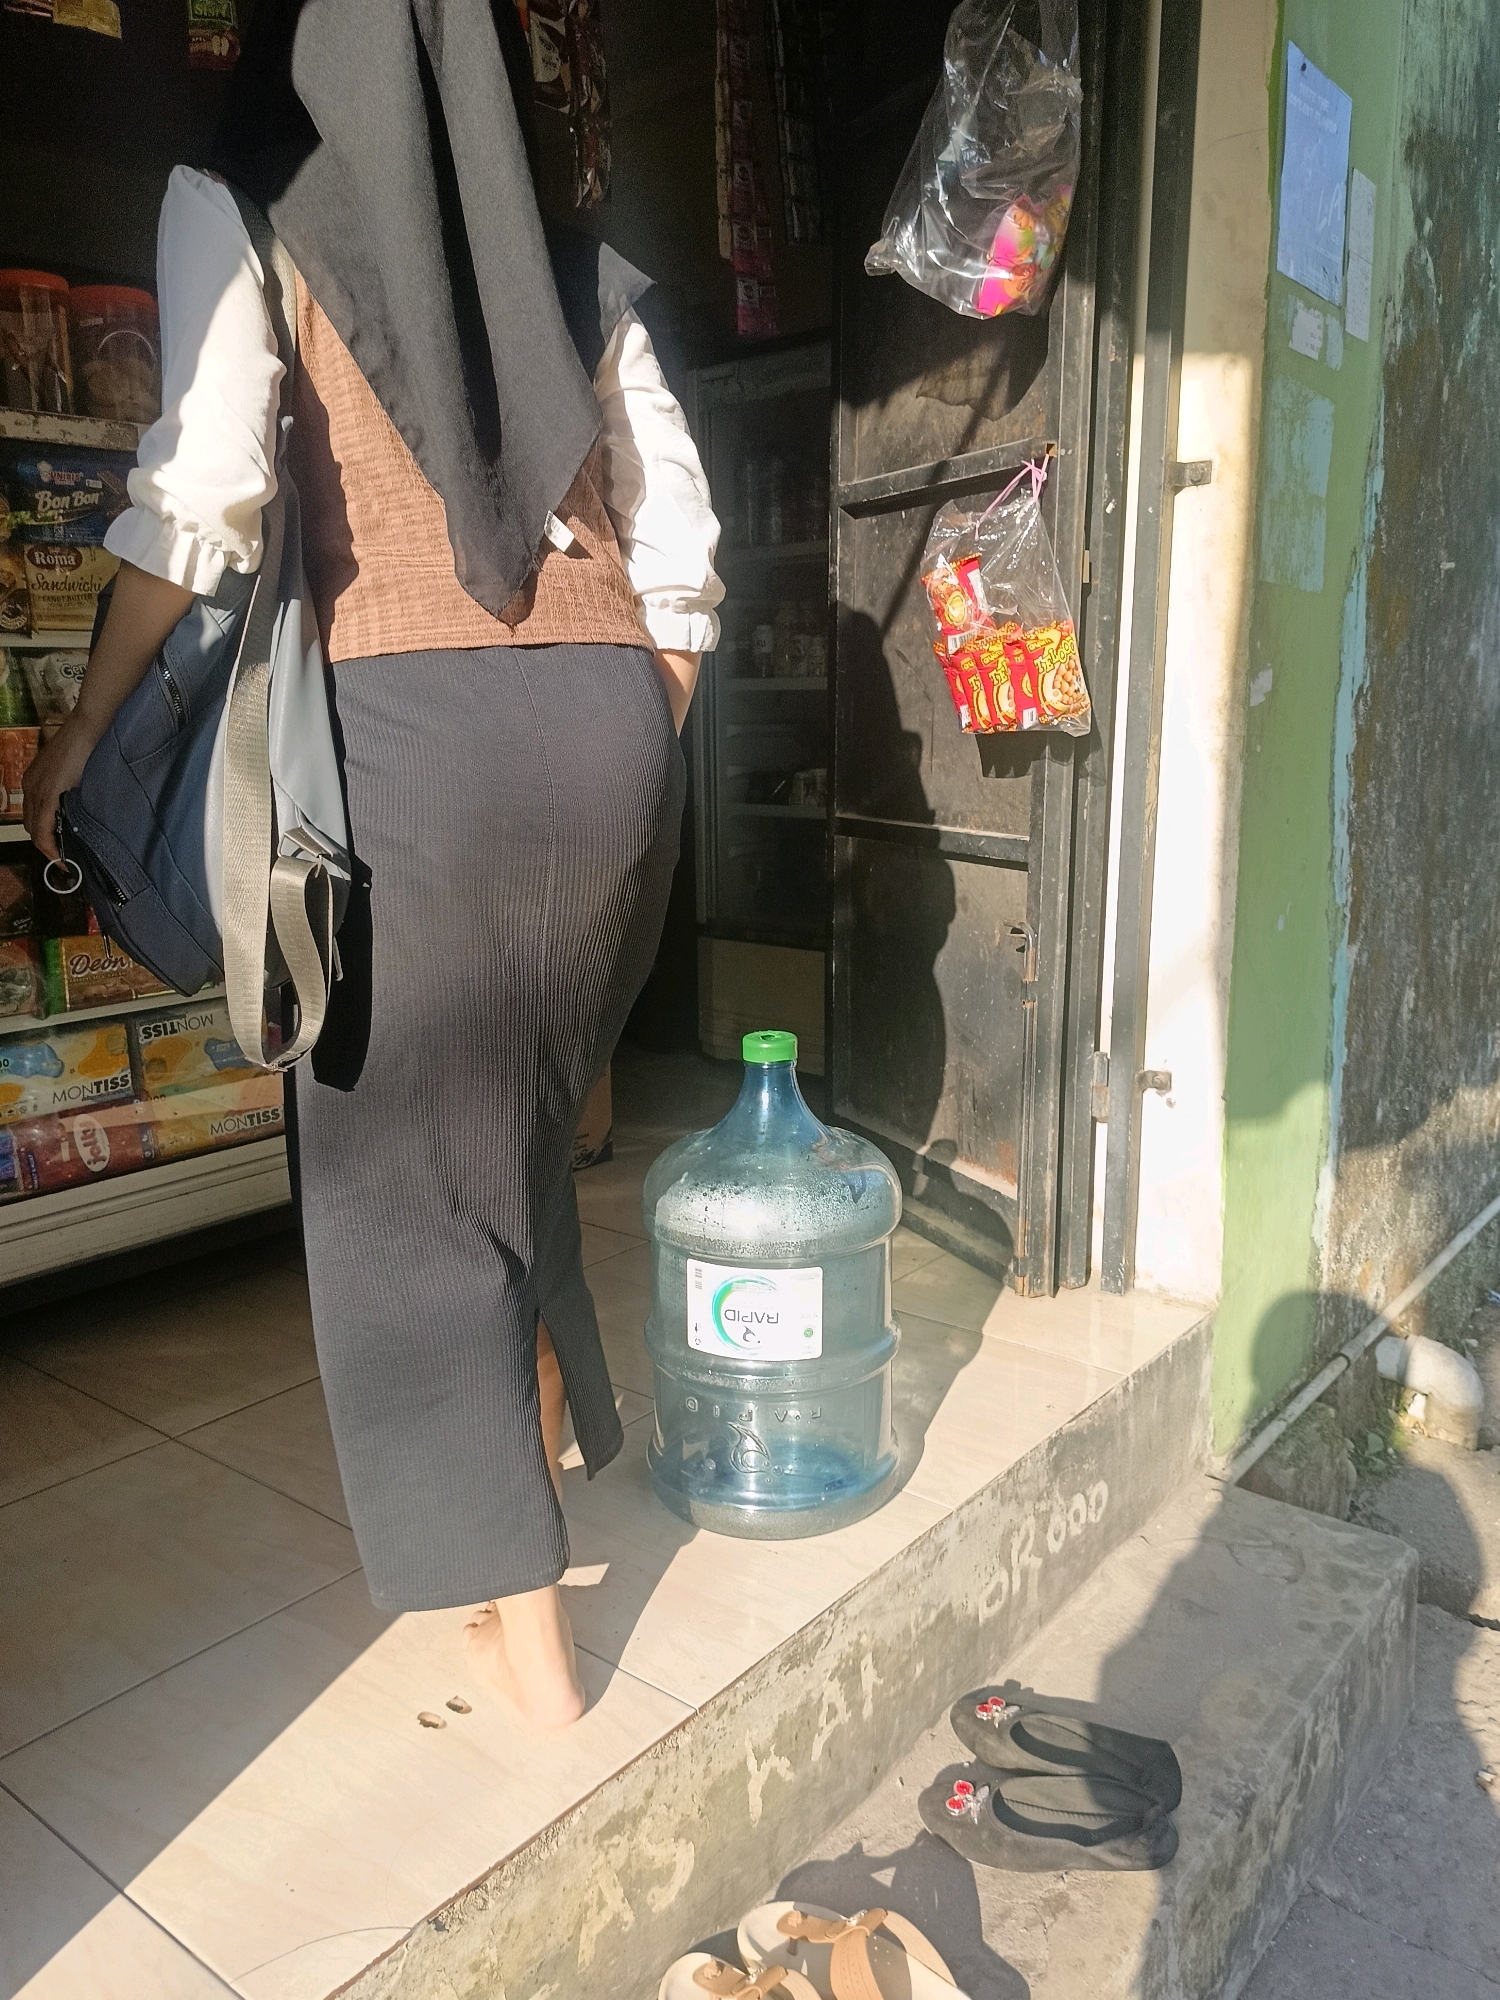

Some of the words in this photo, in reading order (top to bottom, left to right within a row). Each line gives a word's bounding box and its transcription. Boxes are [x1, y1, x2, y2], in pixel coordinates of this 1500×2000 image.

[34, 490, 71, 512] Bon
[71, 490, 100, 508] Bon
[34, 551, 76, 567] Roma
[31, 573, 103, 593] Sandwich
[141, 1013, 214, 1039] MONTISS
[52, 1074, 131, 1104] MONTISS
[209, 1107, 281, 1136] MONTISS
[723, 1308, 780, 1325] RAPID
